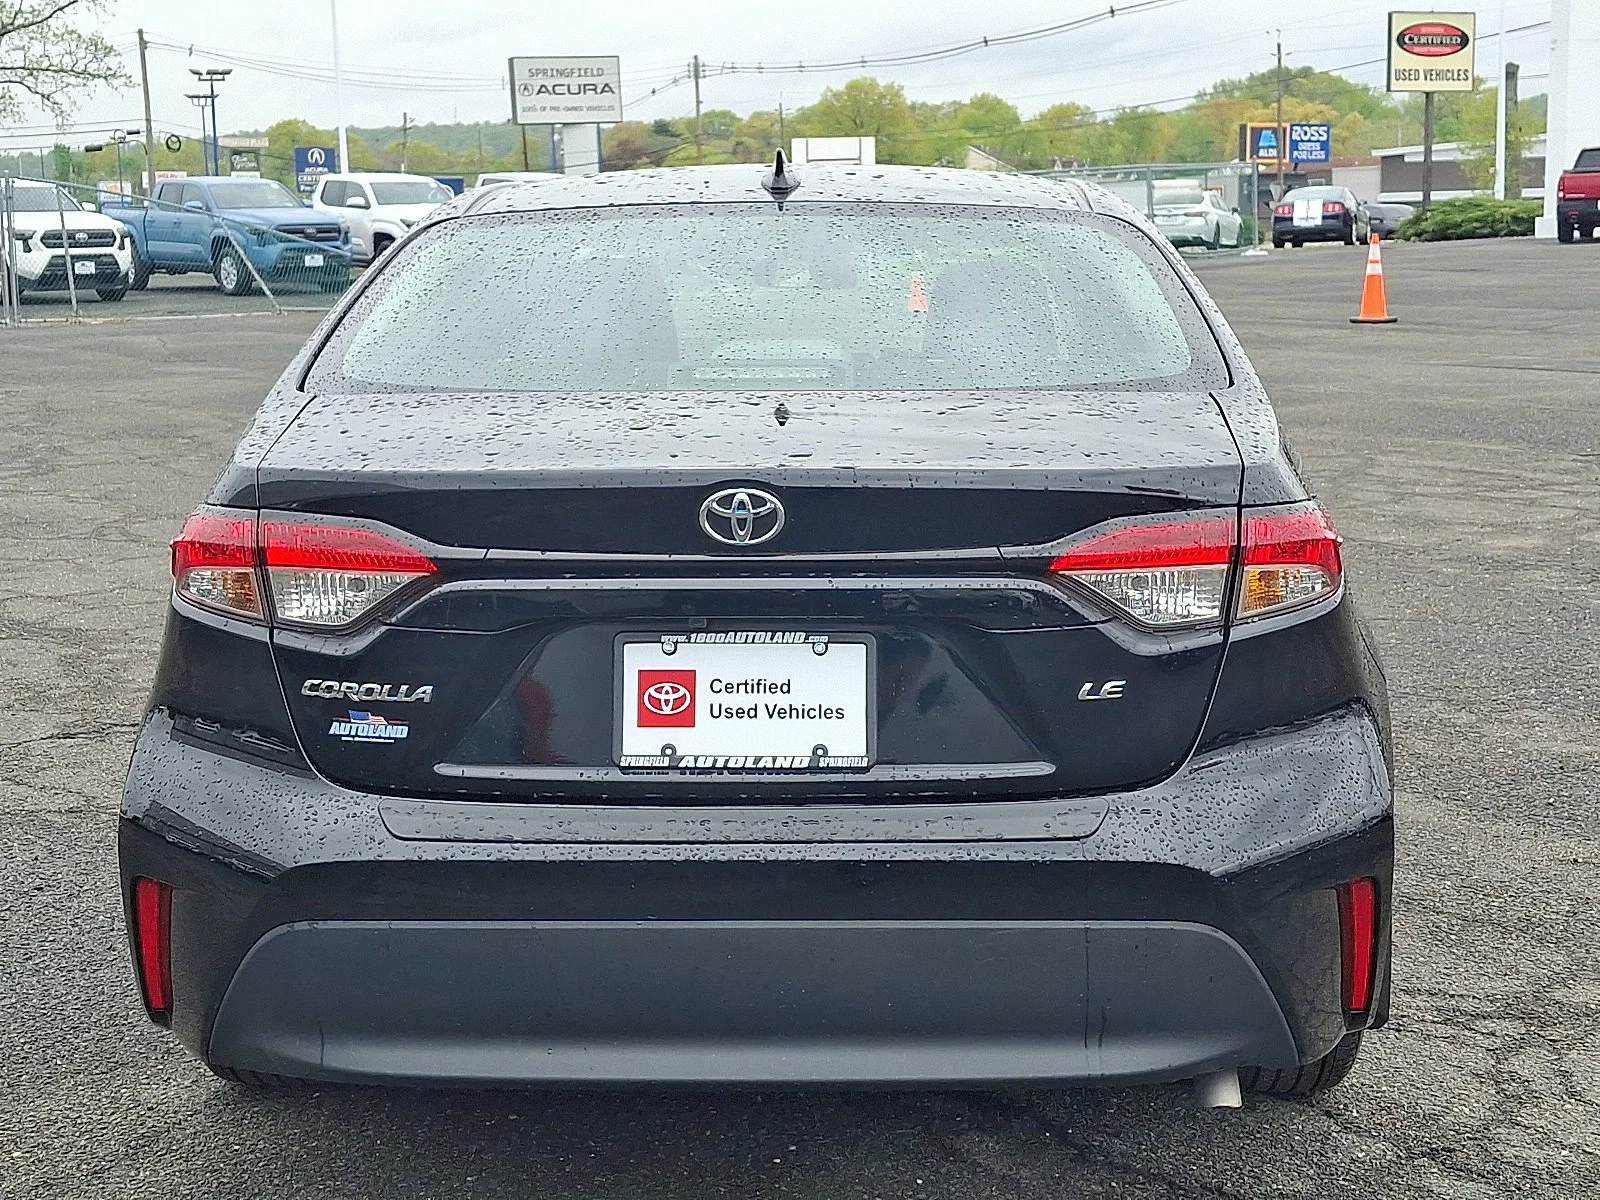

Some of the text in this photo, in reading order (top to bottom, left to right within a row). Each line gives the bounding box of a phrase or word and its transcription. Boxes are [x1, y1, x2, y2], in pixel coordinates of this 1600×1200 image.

[528, 67, 604, 78] SPRINGFIELD
[1395, 68, 1469, 82] USED VEHICLES
[536, 83, 616, 96] ACURA
[1292, 126, 1328, 141] ROSS
[1259, 148, 1277, 157] ALDI
[1298, 142, 1321, 151] DRESS
[1293, 151, 1325, 160] FOR LESS
[301, 679, 434, 703] COROLLA
[709, 678, 791, 694] Certified
[1078, 680, 1127, 700] LE
[709, 702, 845, 720] Used Vehicles
[328, 721, 409, 738] AUTOLAND
[620, 755, 869, 769] SPRINGFIELD AUTOLAND SPRINGFIELD
